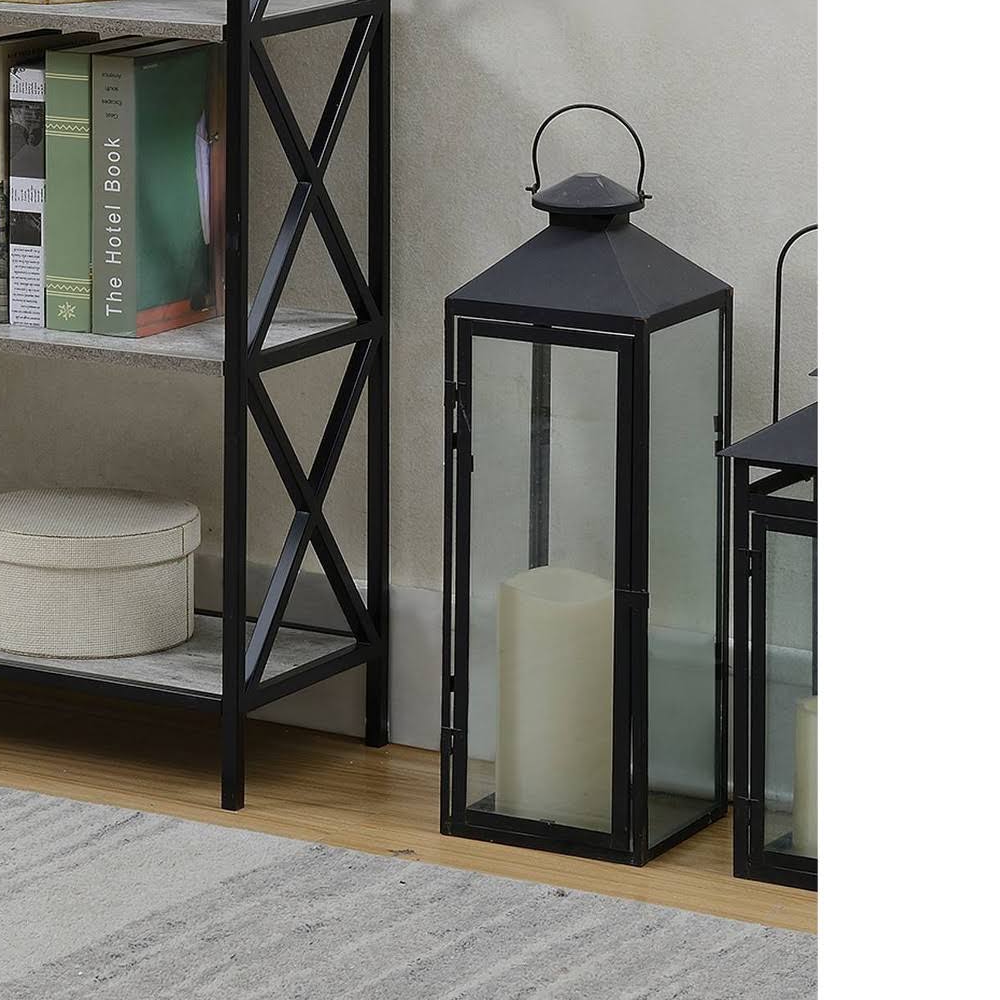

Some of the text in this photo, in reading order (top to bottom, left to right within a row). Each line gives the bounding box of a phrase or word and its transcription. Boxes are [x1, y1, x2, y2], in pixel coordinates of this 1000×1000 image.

[103, 136, 123, 317] The Hotel Book
